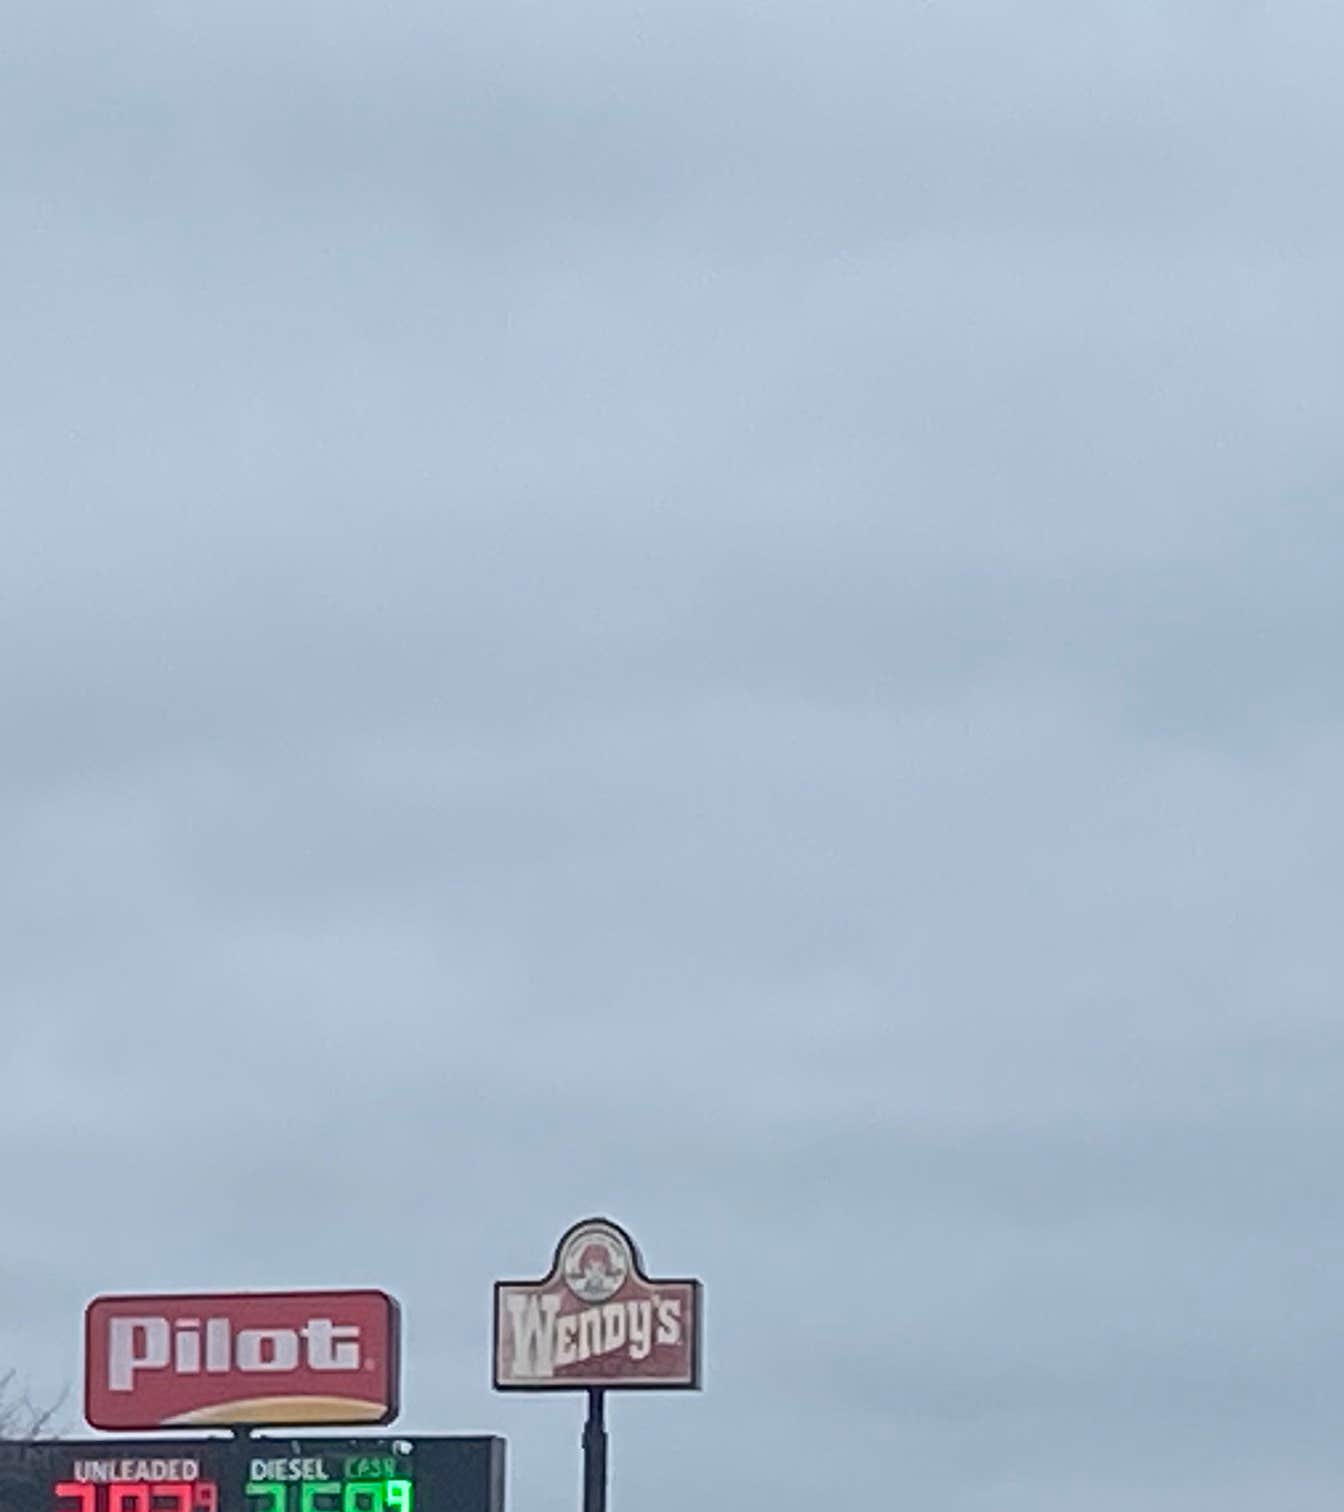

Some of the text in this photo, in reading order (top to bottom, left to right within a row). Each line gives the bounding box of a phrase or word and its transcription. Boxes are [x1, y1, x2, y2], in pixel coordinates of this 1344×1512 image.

[108, 1316, 361, 1391] Pilot
[506, 1292, 682, 1379] Wendy's
[73, 1459, 200, 1482] UNLEADED
[250, 1458, 329, 1480] DIESEL
